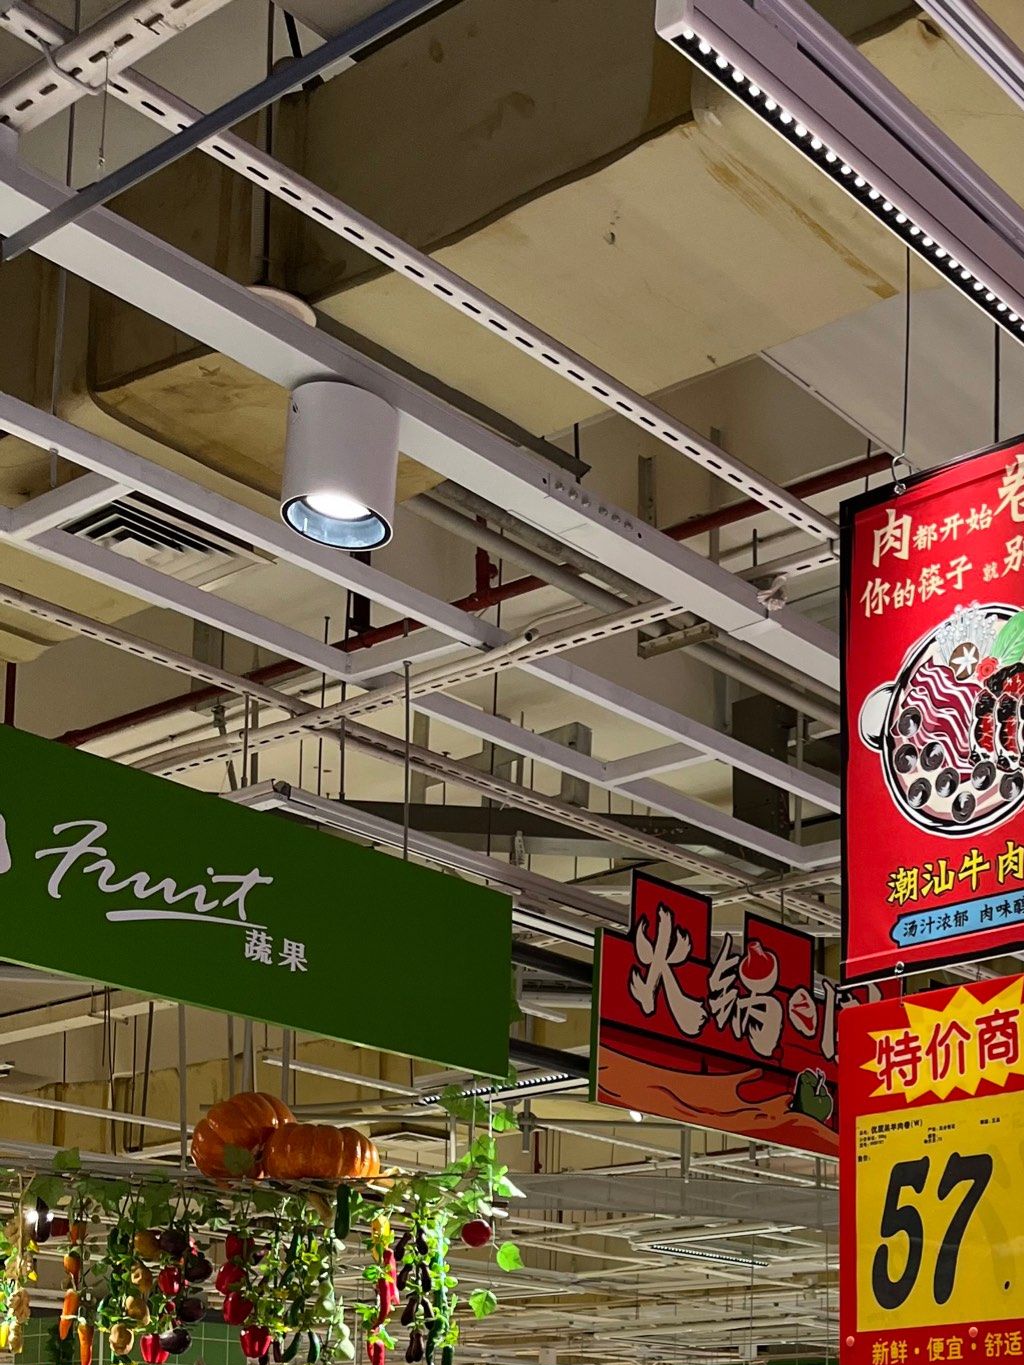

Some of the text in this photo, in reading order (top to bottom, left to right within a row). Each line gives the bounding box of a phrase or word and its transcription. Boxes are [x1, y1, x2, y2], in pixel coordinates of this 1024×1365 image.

[35, 820, 273, 922] Fruit
[903, 909, 969, 938] 汤汁浓郁
[245, 930, 308, 972] 蔬果
